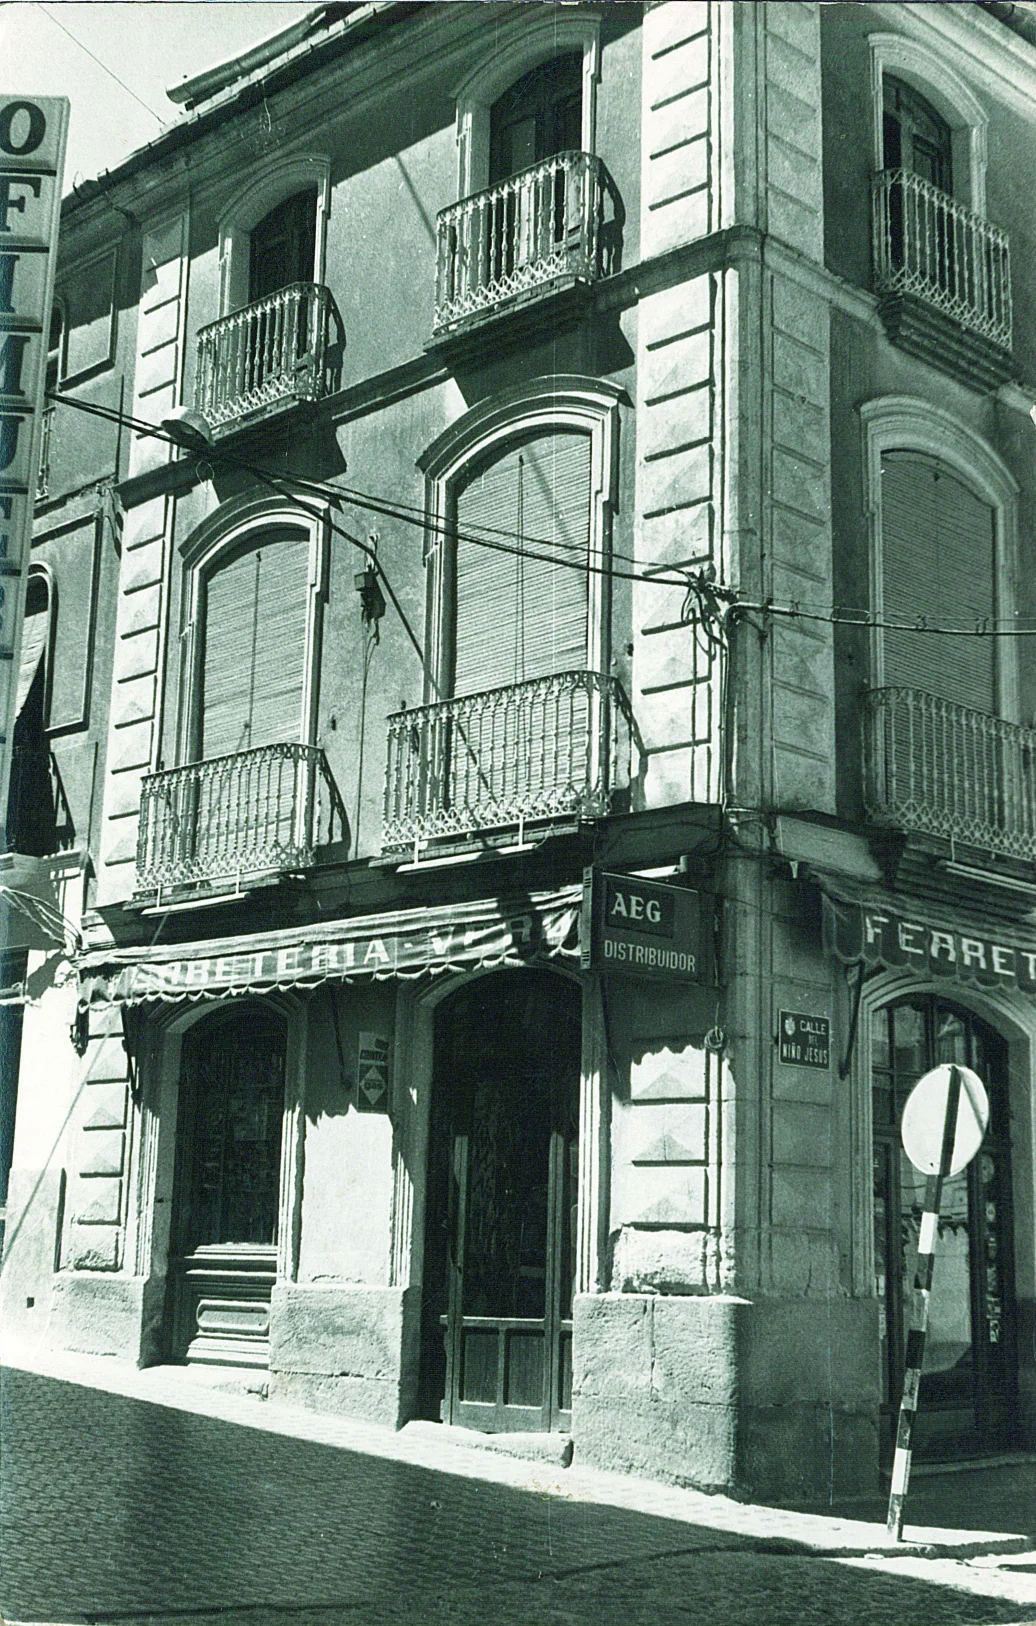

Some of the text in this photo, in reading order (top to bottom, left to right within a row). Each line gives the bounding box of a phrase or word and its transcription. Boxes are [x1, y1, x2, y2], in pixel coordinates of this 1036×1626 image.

[611, 892, 661, 923] AEG
[133, 938, 390, 988] RRETERIA
[604, 940, 696, 973] DISTRIBUIDOR
[865, 915, 1036, 980] FERRET
[800, 1020, 827, 1036] CALLE
[782, 1042, 801, 1060] NIÑO
